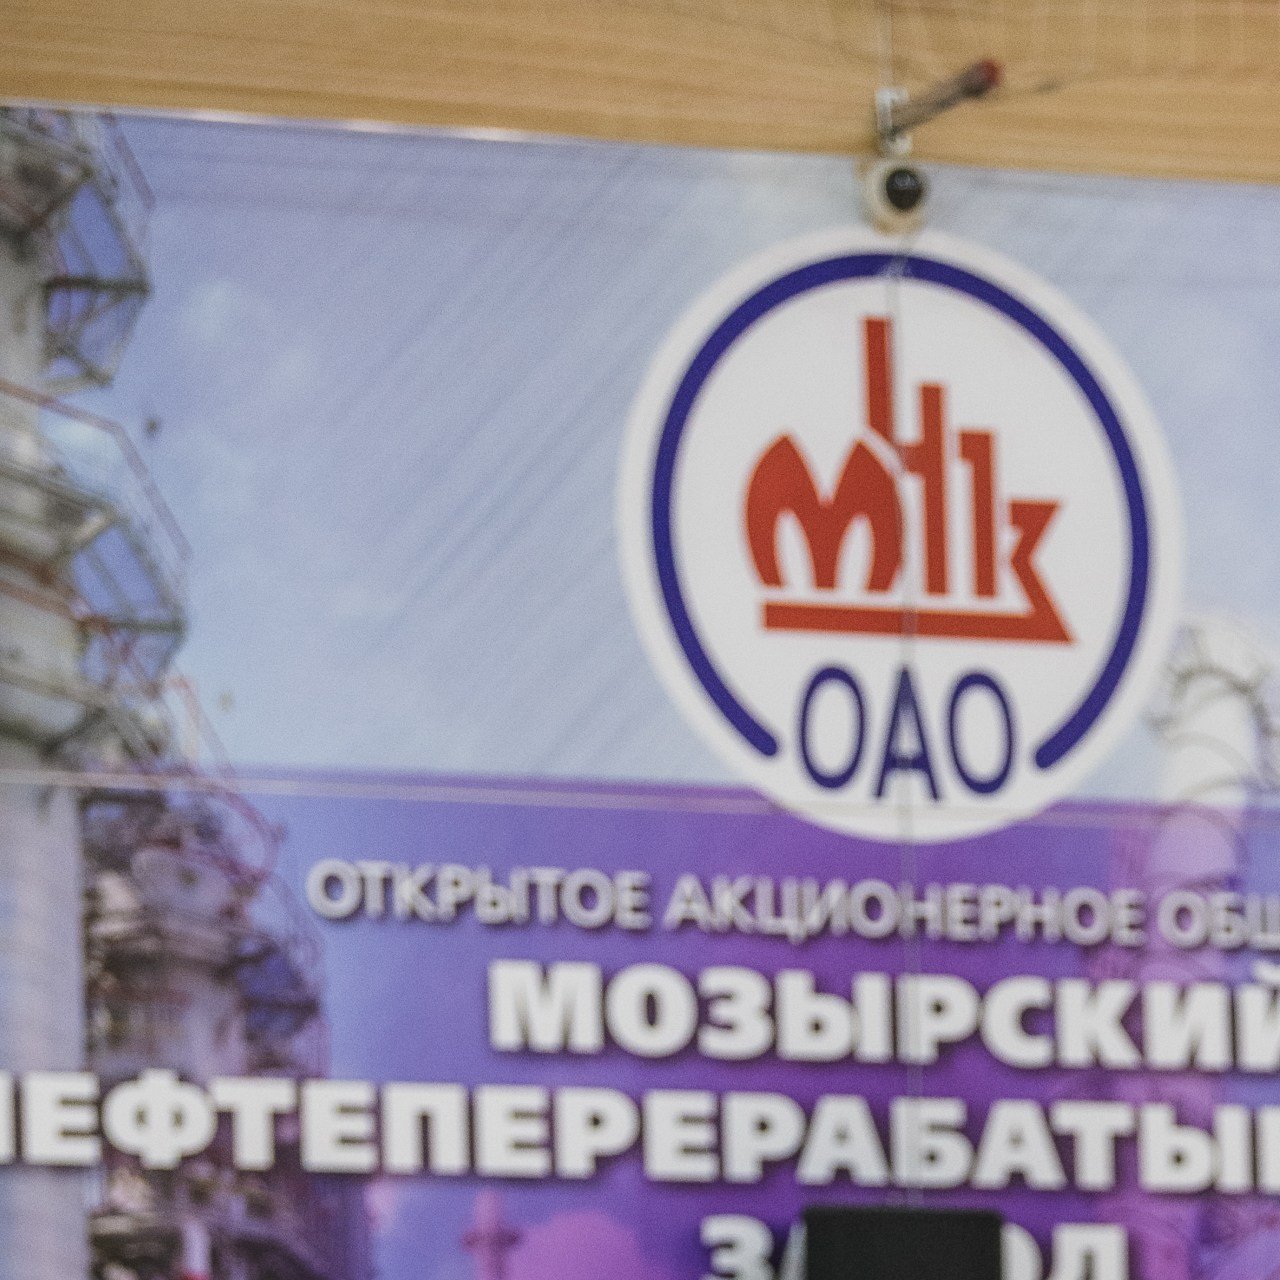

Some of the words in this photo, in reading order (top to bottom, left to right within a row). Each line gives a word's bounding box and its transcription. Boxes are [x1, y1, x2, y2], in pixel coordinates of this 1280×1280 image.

[800, 664, 1015, 800] ОАО
[304, 858, 652, 931] ОТКРЫТОЕ
[663, 874, 1147, 948] АКЦИОНЕРНОЕ
